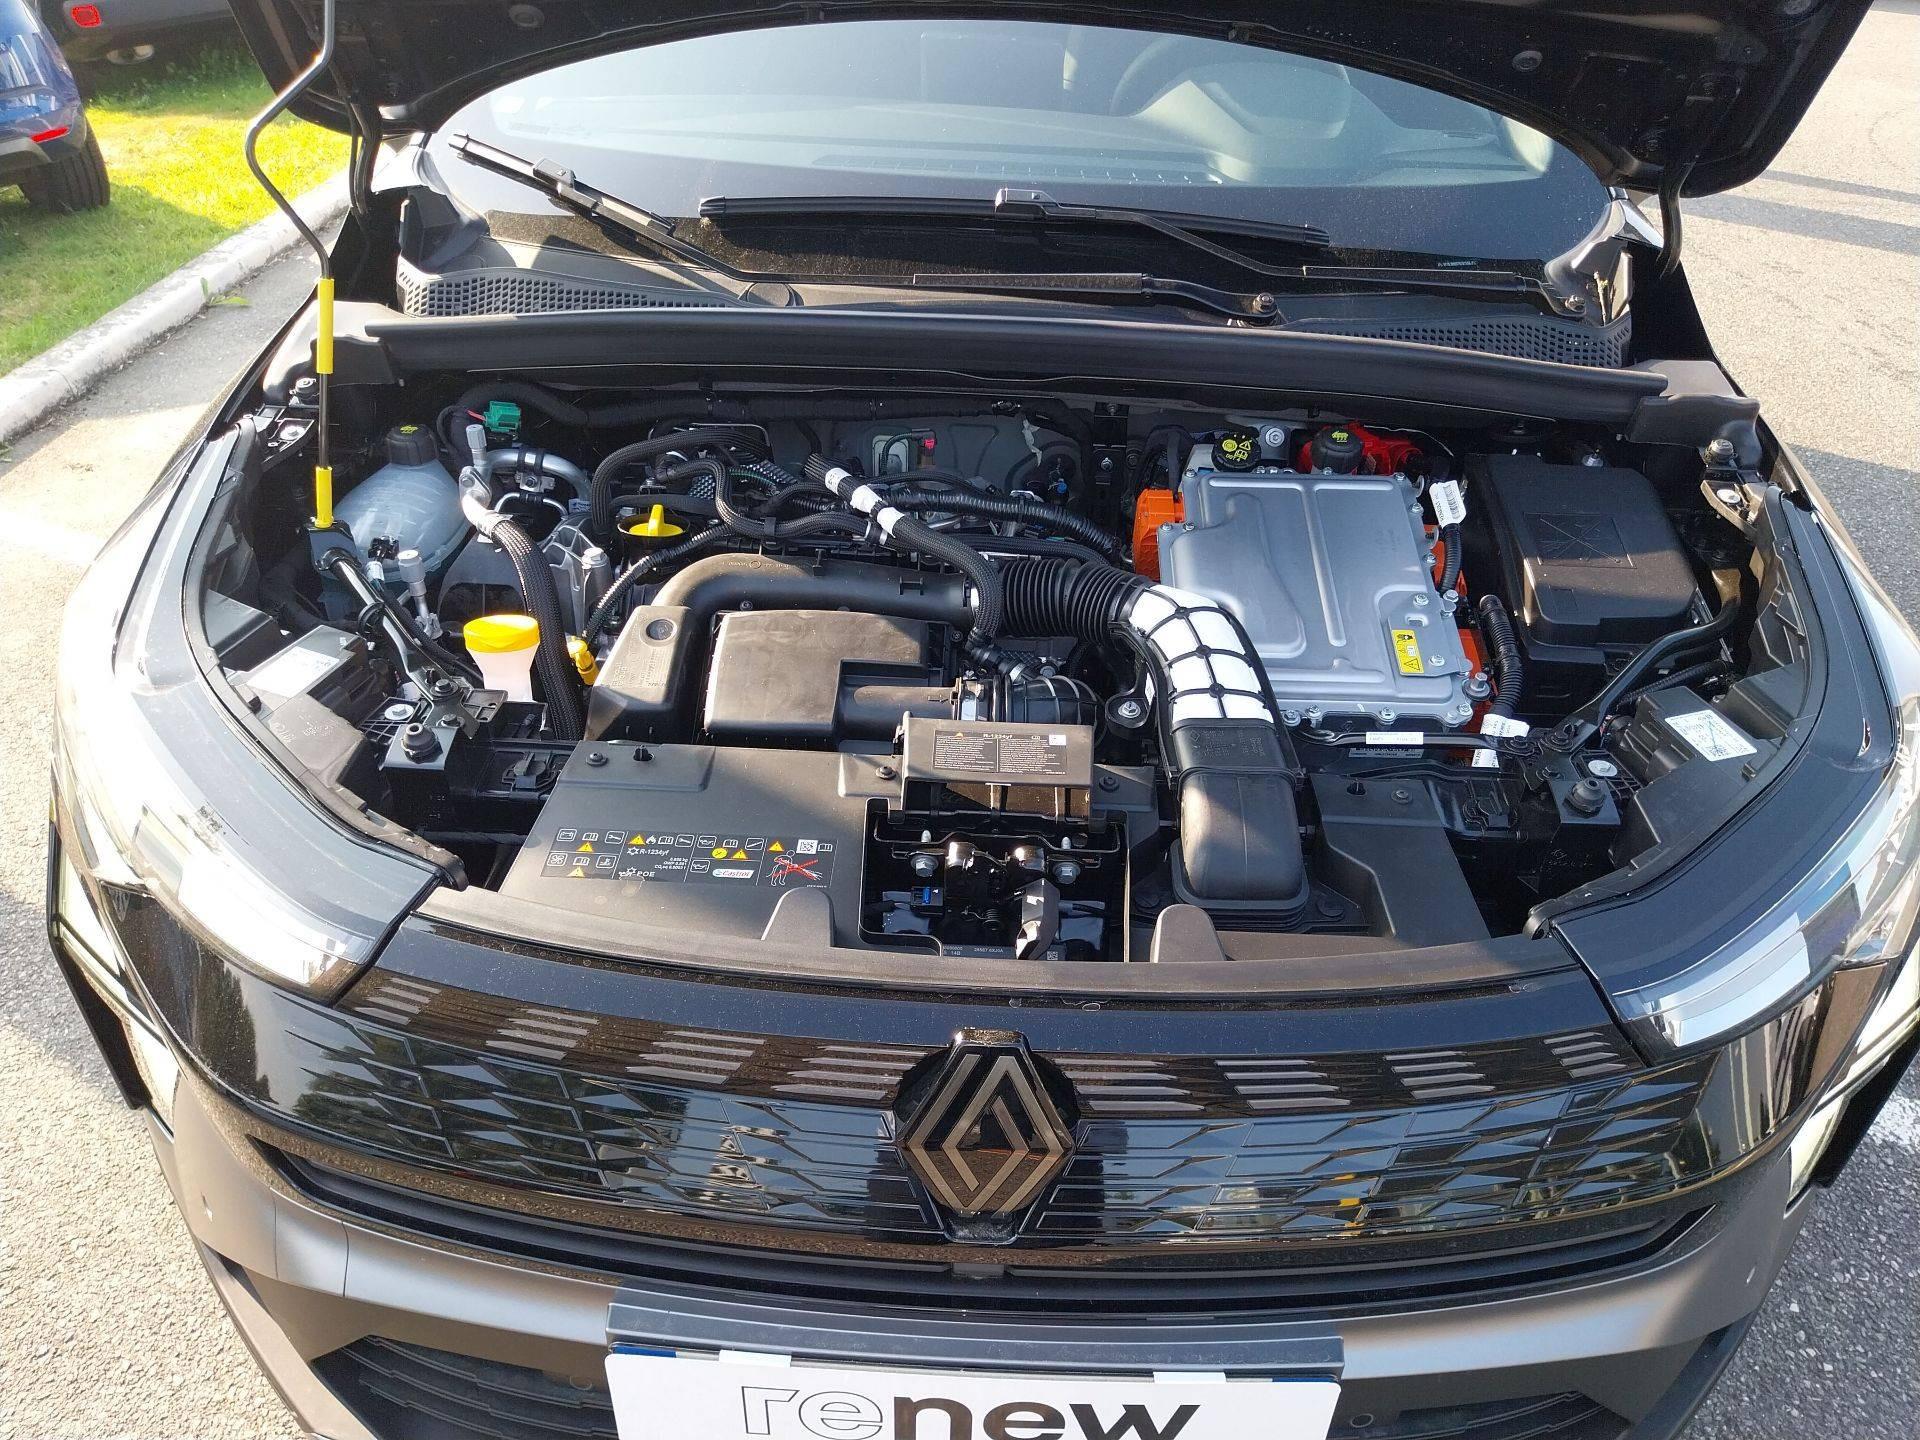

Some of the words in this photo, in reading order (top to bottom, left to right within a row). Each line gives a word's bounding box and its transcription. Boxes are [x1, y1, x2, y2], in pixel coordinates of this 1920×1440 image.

[639, 848, 670, 857] R-1234yf
[721, 870, 750, 878] Castrol
[741, 1385, 1201, 1440] renew
